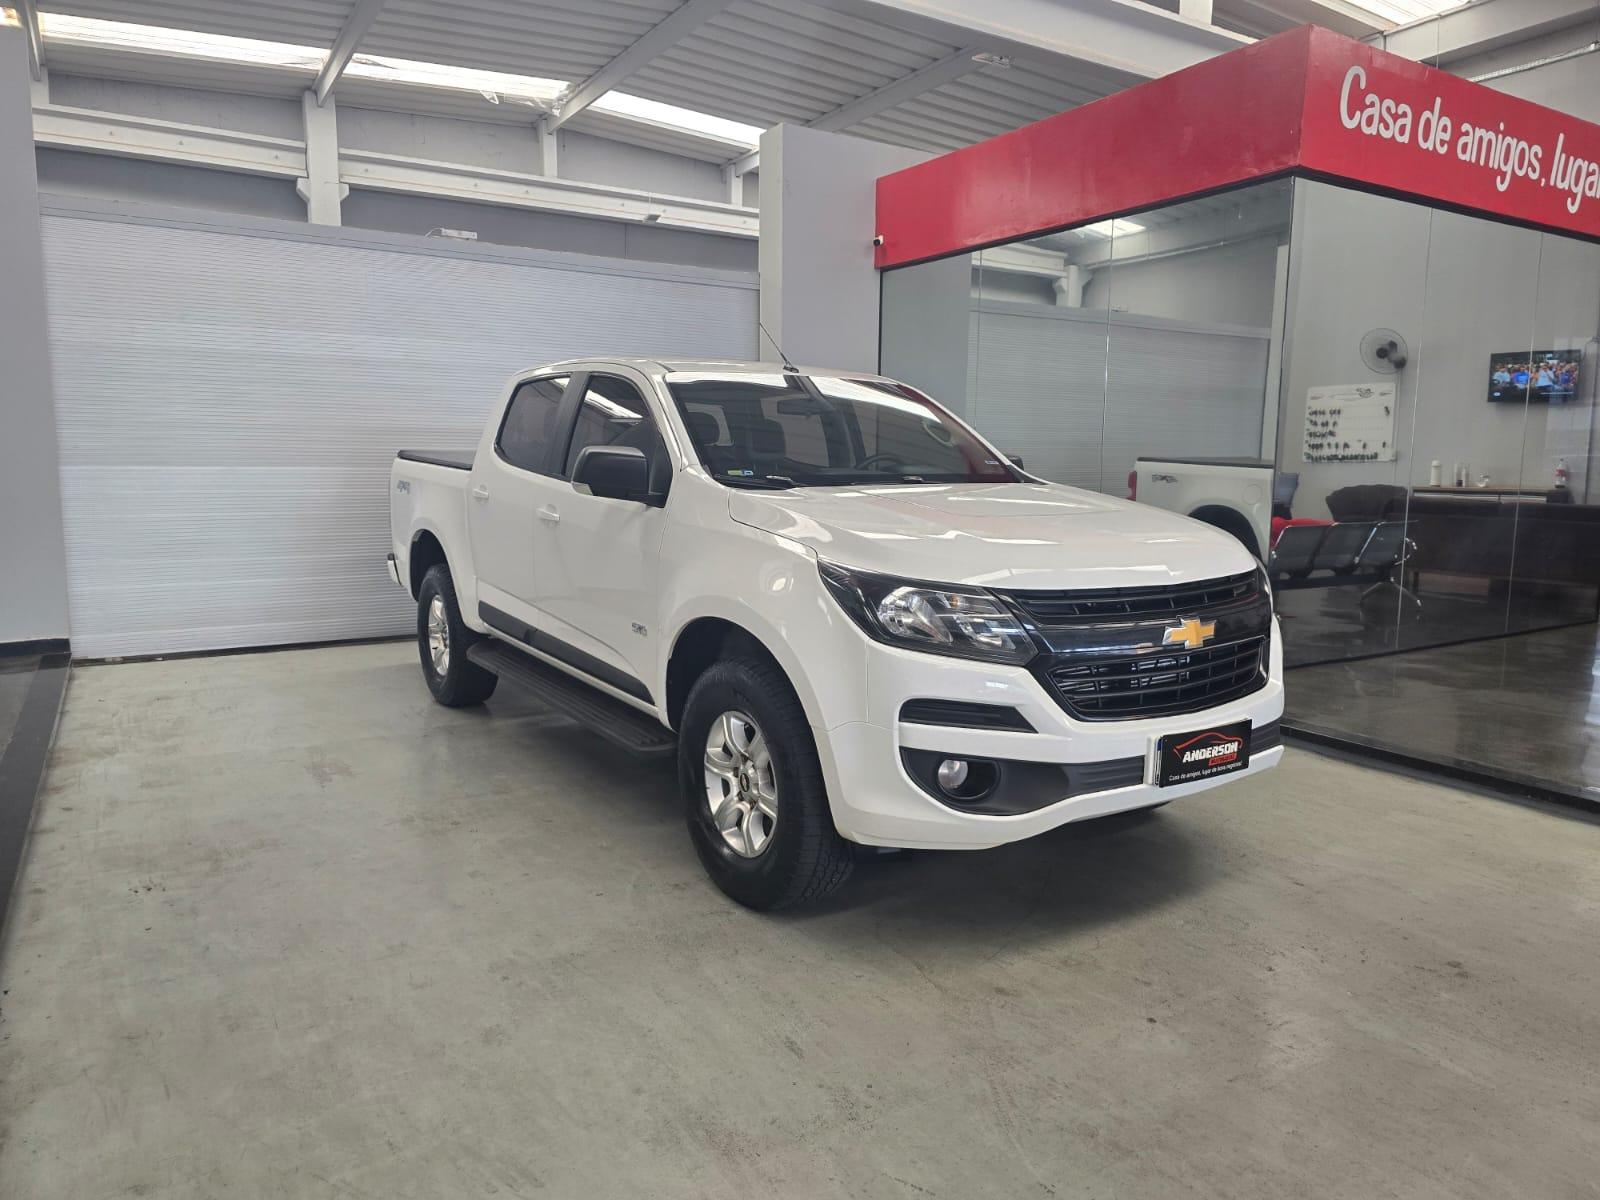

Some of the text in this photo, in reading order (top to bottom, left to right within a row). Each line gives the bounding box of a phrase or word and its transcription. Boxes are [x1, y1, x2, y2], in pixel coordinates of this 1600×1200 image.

[1340, 65, 1413, 144] Casa
[1418, 96, 1451, 154] de
[1457, 121, 1546, 192] amigos,
[1182, 741, 1239, 763] ANDERSON
